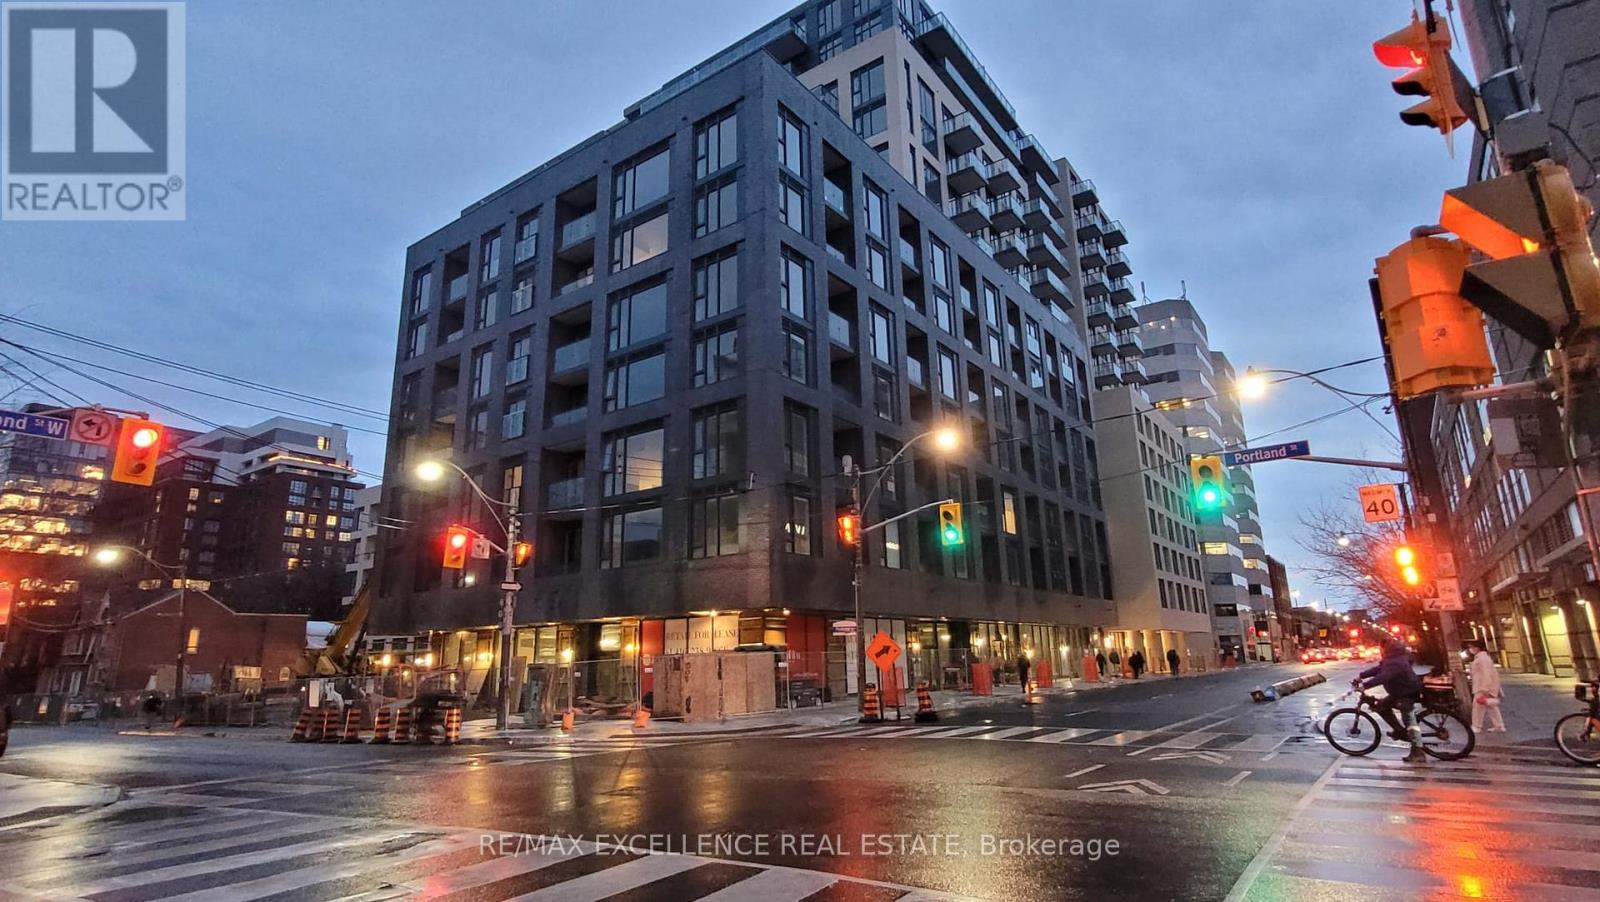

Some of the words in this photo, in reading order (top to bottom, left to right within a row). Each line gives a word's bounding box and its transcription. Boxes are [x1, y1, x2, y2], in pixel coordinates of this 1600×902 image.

[47, 421, 63, 435] W
[1234, 446, 1287, 464] Portland
[1366, 499, 1395, 516] 40
[694, 630, 710, 640] FOR
